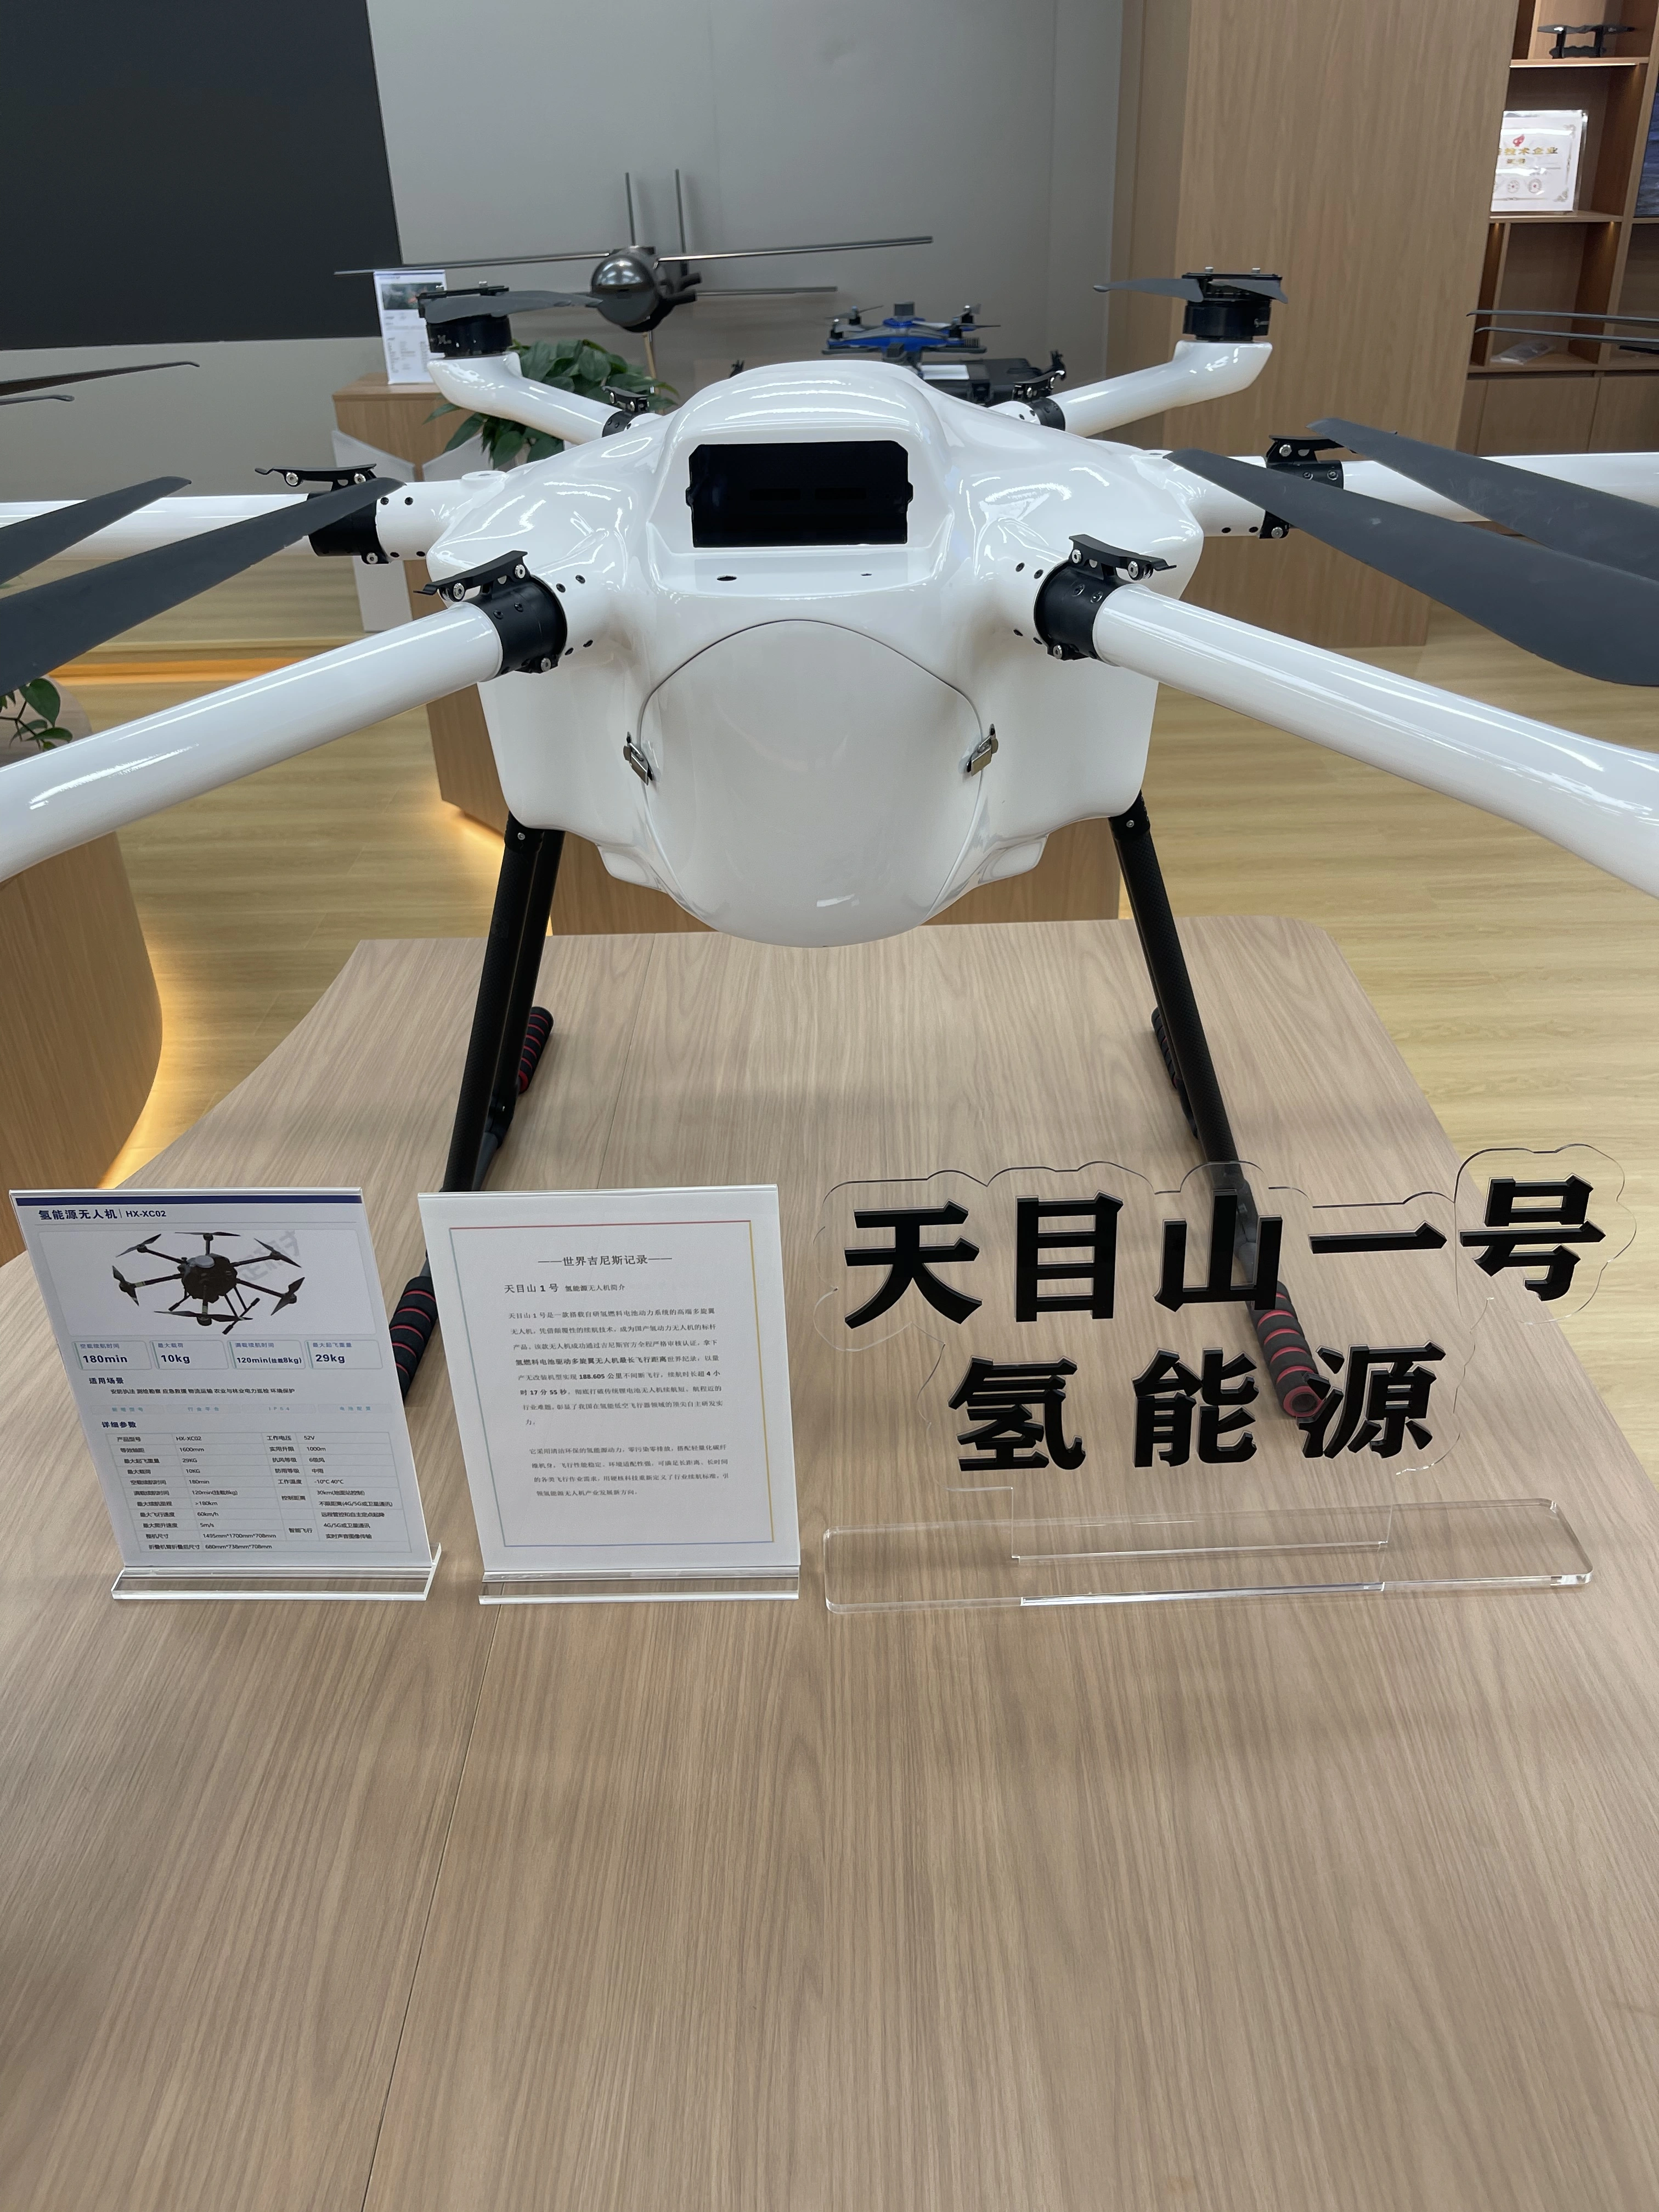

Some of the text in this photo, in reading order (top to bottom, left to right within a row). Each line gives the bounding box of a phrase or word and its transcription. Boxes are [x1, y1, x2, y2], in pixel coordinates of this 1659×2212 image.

[38, 1209, 118, 1220] 氢能源无人机
[844, 1173, 1606, 1329] 天目山一号
[565, 1284, 625, 1293] 氢能源无人机简介
[82, 1355, 128, 1363] 180min
[161, 1355, 190, 1364] 10kg
[315, 1354, 345, 1364] 29kg
[947, 1339, 1447, 1473] 氢能源
